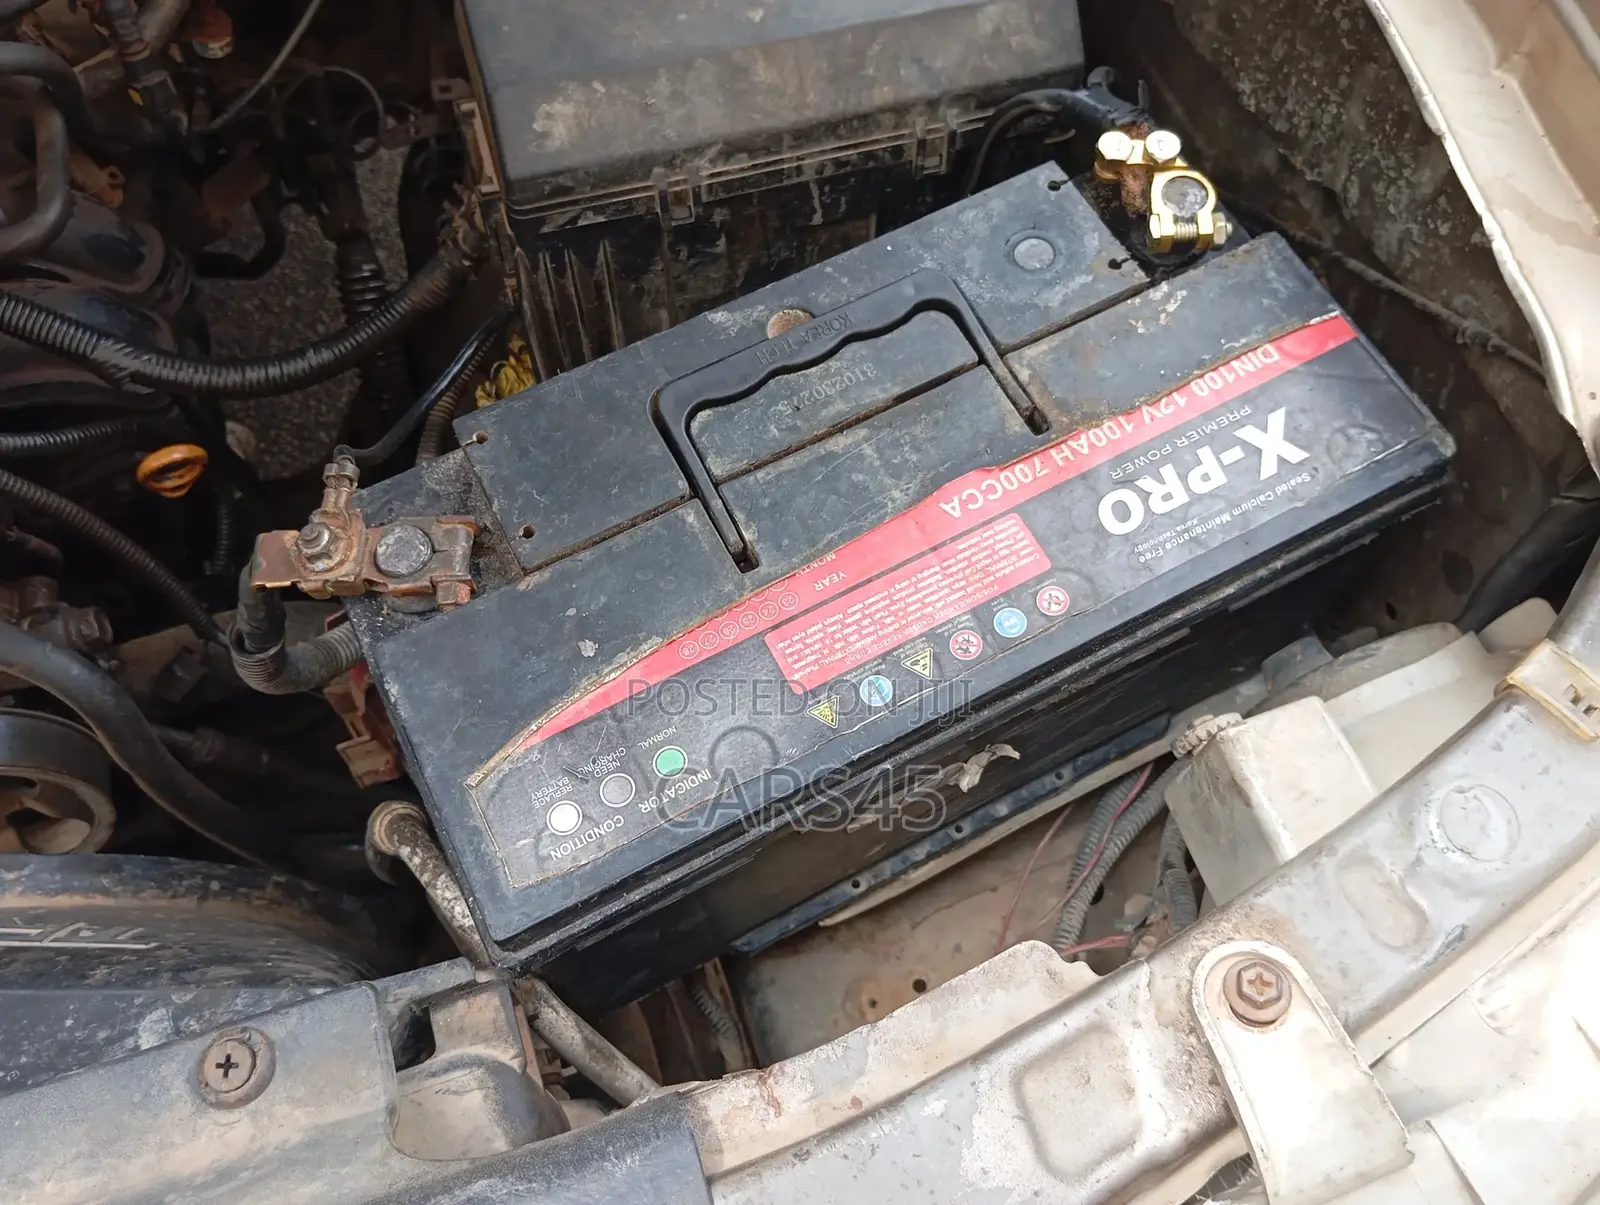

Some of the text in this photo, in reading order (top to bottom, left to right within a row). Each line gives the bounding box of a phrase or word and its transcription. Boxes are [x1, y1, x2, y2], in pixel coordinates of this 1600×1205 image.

[798, 311, 852, 346] KOREA
[937, 340, 1280, 523] DIN100 12V 100AH 700CCA
[1108, 403, 1250, 480] PREMIER POWER
[1098, 406, 1310, 536] X-PRO
[1137, 471, 1310, 565] Sealed Calcium Maintenance Free
[1132, 517, 1198, 554] Korea Technology
[812, 568, 846, 591] YEAR
[781, 595, 793, 606] 23
[721, 624, 734, 636] 26
[741, 614, 754, 626] 25
[681, 643, 695, 655] 28
[701, 633, 714, 645] 27
[637, 724, 677, 750] NORMAL
[576, 745, 627, 777] CHARGING
[592, 758, 620, 777] NEED
[528, 775, 569, 801] BATTERY
[531, 782, 573, 808] REPLACE
[548, 768, 712, 861] INDICATOR CONDITION
